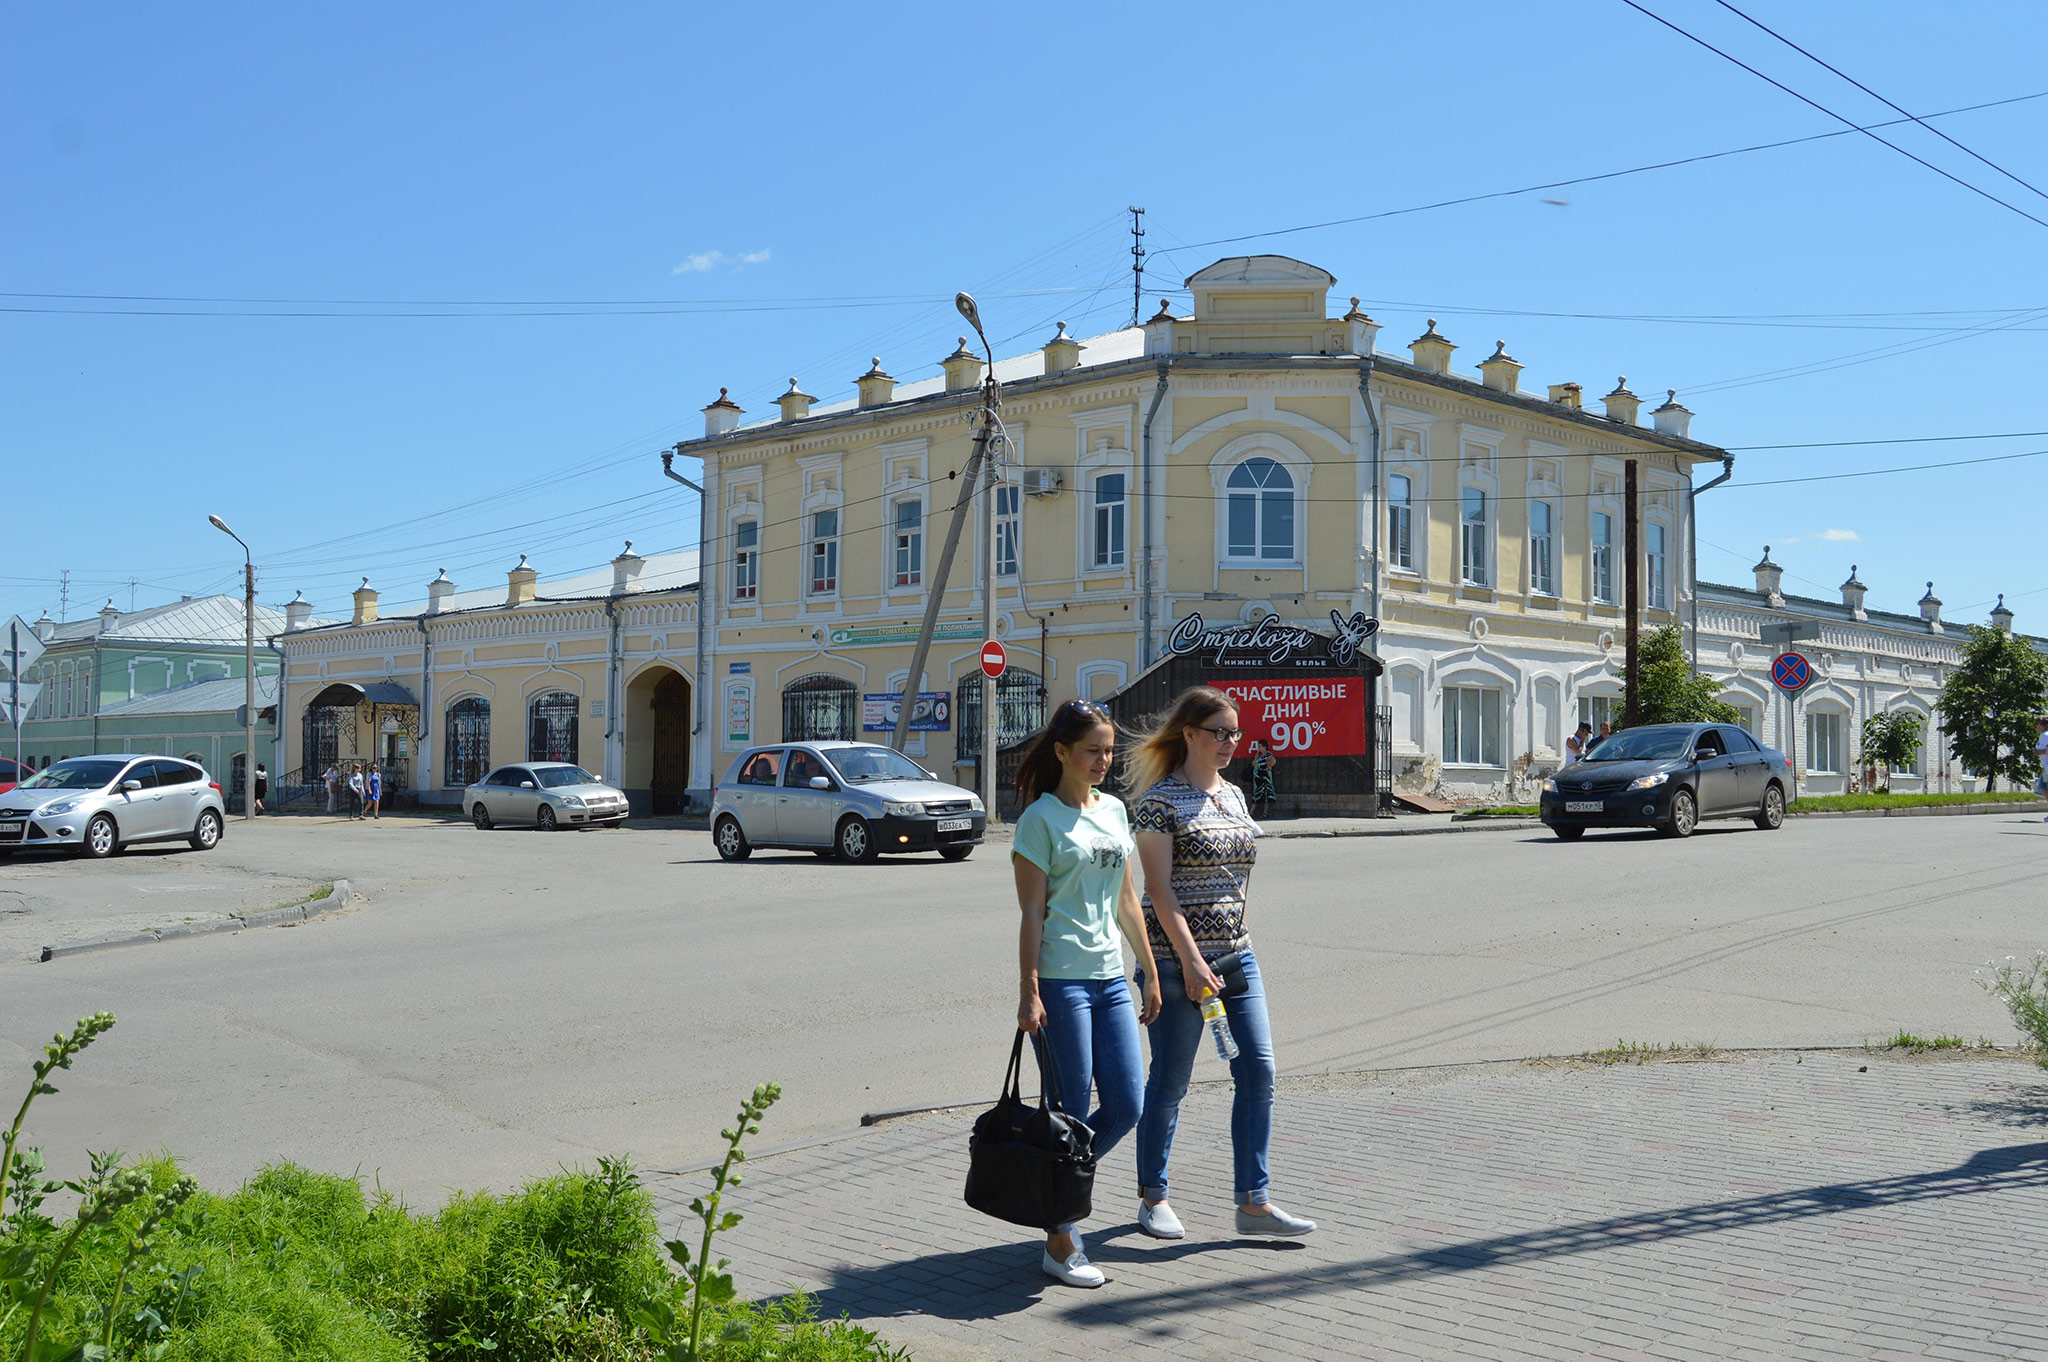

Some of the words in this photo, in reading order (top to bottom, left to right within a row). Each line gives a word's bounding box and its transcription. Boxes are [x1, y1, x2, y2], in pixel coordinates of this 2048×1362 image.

[943, 623, 984, 631] ПОЛИКЛИНИК
[1168, 611, 1315, 666] Стрекоза
[1224, 659, 1263, 667] НИЖНЕЕ
[1295, 659, 1327, 667] БЕЛЬЕ
[1225, 684, 1347, 702] СЧАСТЛИВЫЕ
[1262, 702, 1310, 722] ДНИ!
[1271, 721, 1327, 751] 90%
